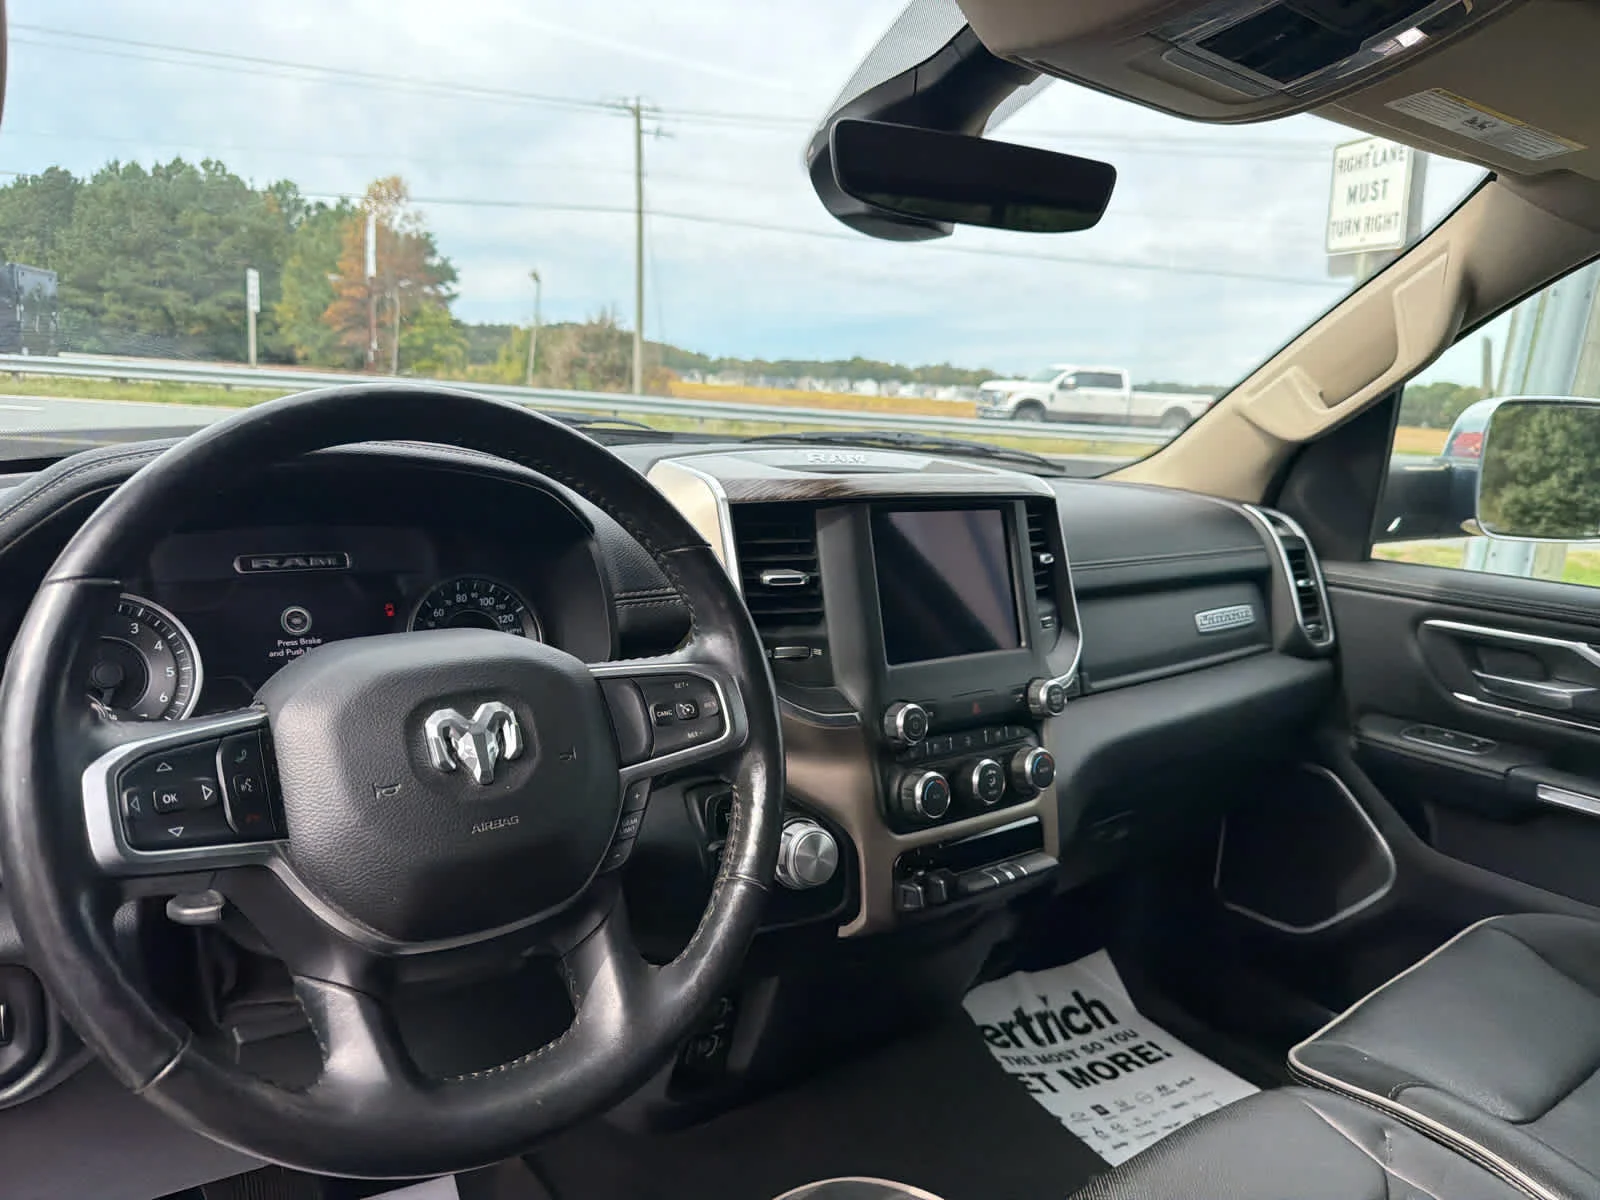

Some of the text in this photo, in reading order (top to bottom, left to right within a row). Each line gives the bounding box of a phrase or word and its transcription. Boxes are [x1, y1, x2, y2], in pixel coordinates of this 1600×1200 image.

[1337, 146, 1404, 174] RIGHT LANE
[1346, 179, 1389, 206] MUST
[1330, 211, 1400, 237] TURN RIGHT
[807, 453, 867, 464] RAM
[251, 557, 338, 569] RAM
[455, 593, 467, 603] 80
[480, 596, 495, 606] 100
[433, 608, 445, 618] 60
[498, 613, 514, 624] 120
[130, 622, 139, 634] 3
[153, 640, 163, 651] 4
[277, 637, 322, 647] Press Brake
[268, 648, 285, 657] and
[286, 647, 305, 656] Push
[166, 667, 175, 678] 5
[159, 691, 169, 703] 6
[162, 792, 178, 804] OK
[471, 815, 519, 834] AIRBAG
[981, 989, 1120, 1049] ertrich
[1002, 1029, 1139, 1067] THE MOST SO YOU
[1056, 1040, 1174, 1090] MORE!
